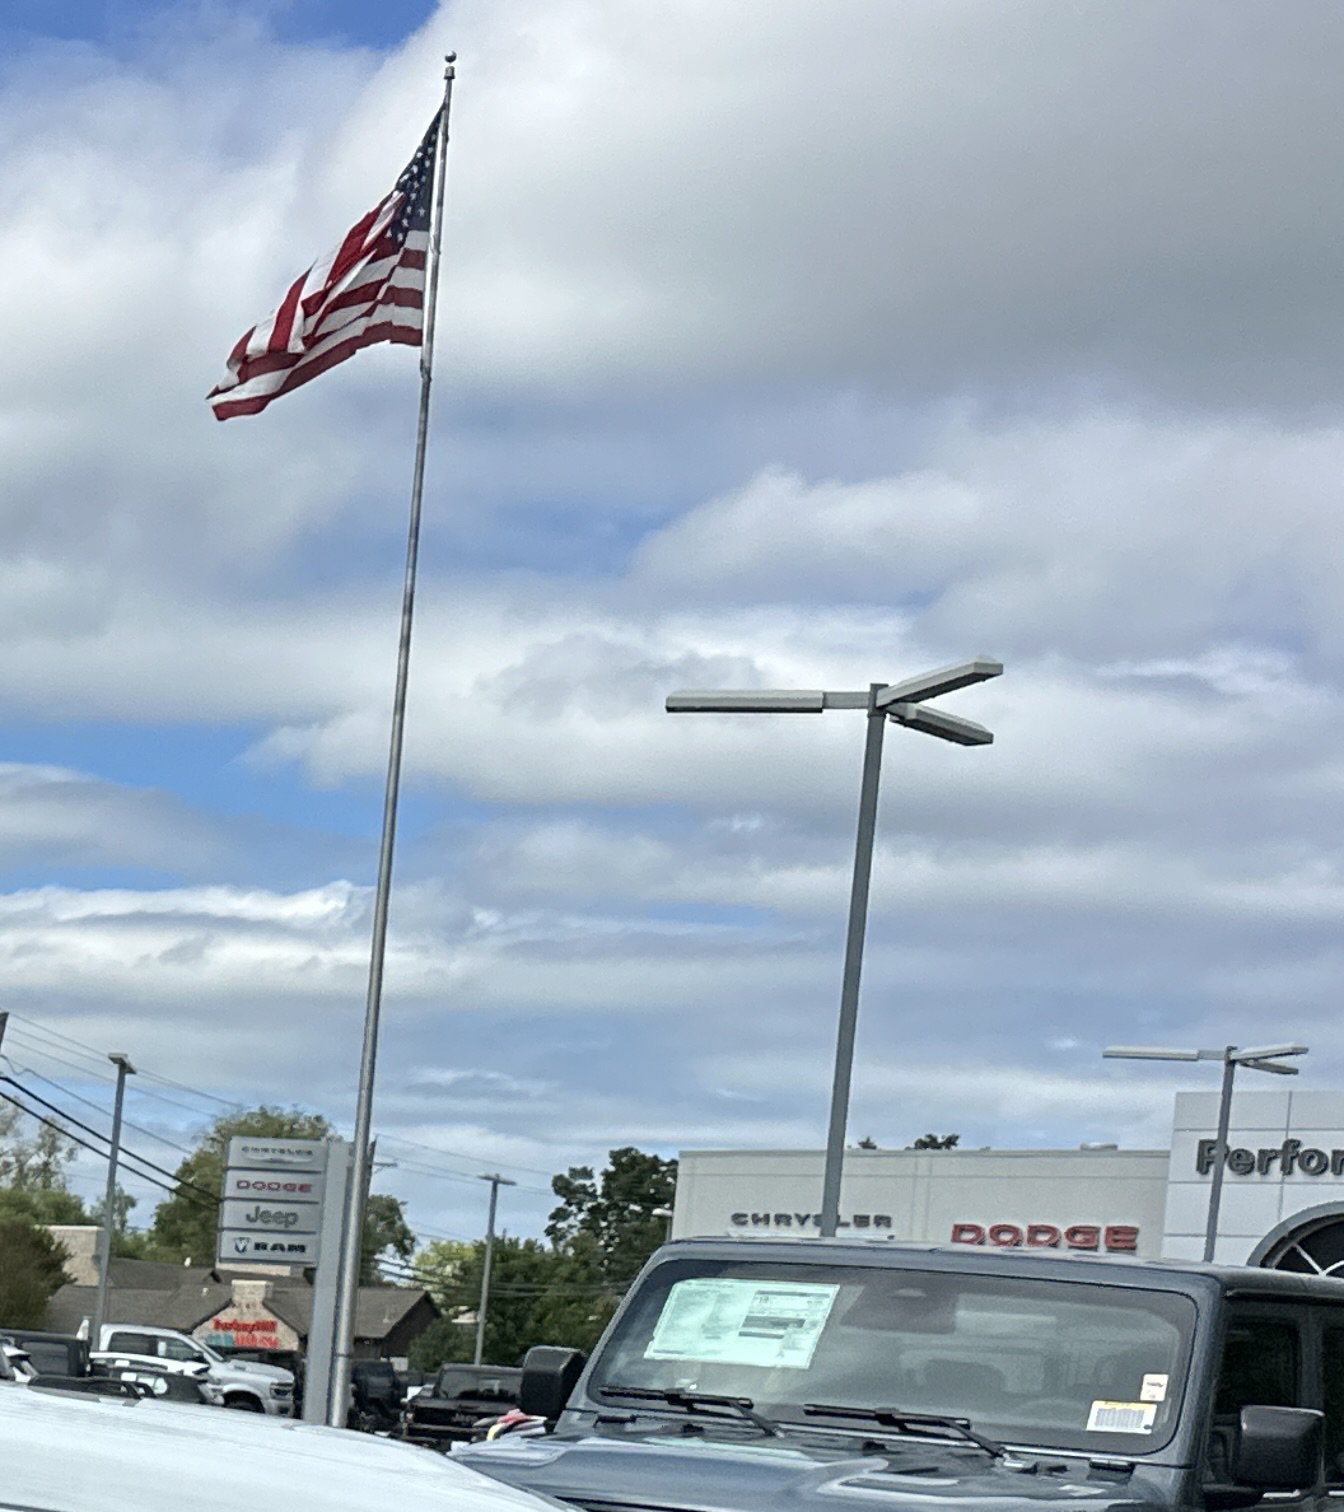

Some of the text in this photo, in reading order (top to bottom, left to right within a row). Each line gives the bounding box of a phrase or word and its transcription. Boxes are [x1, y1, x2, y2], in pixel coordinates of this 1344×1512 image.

[236, 1179, 312, 1193] DODGE
[246, 1205, 299, 1228] Jeep
[951, 1223, 1139, 1252] DODGE
[254, 1241, 307, 1253] RAM
